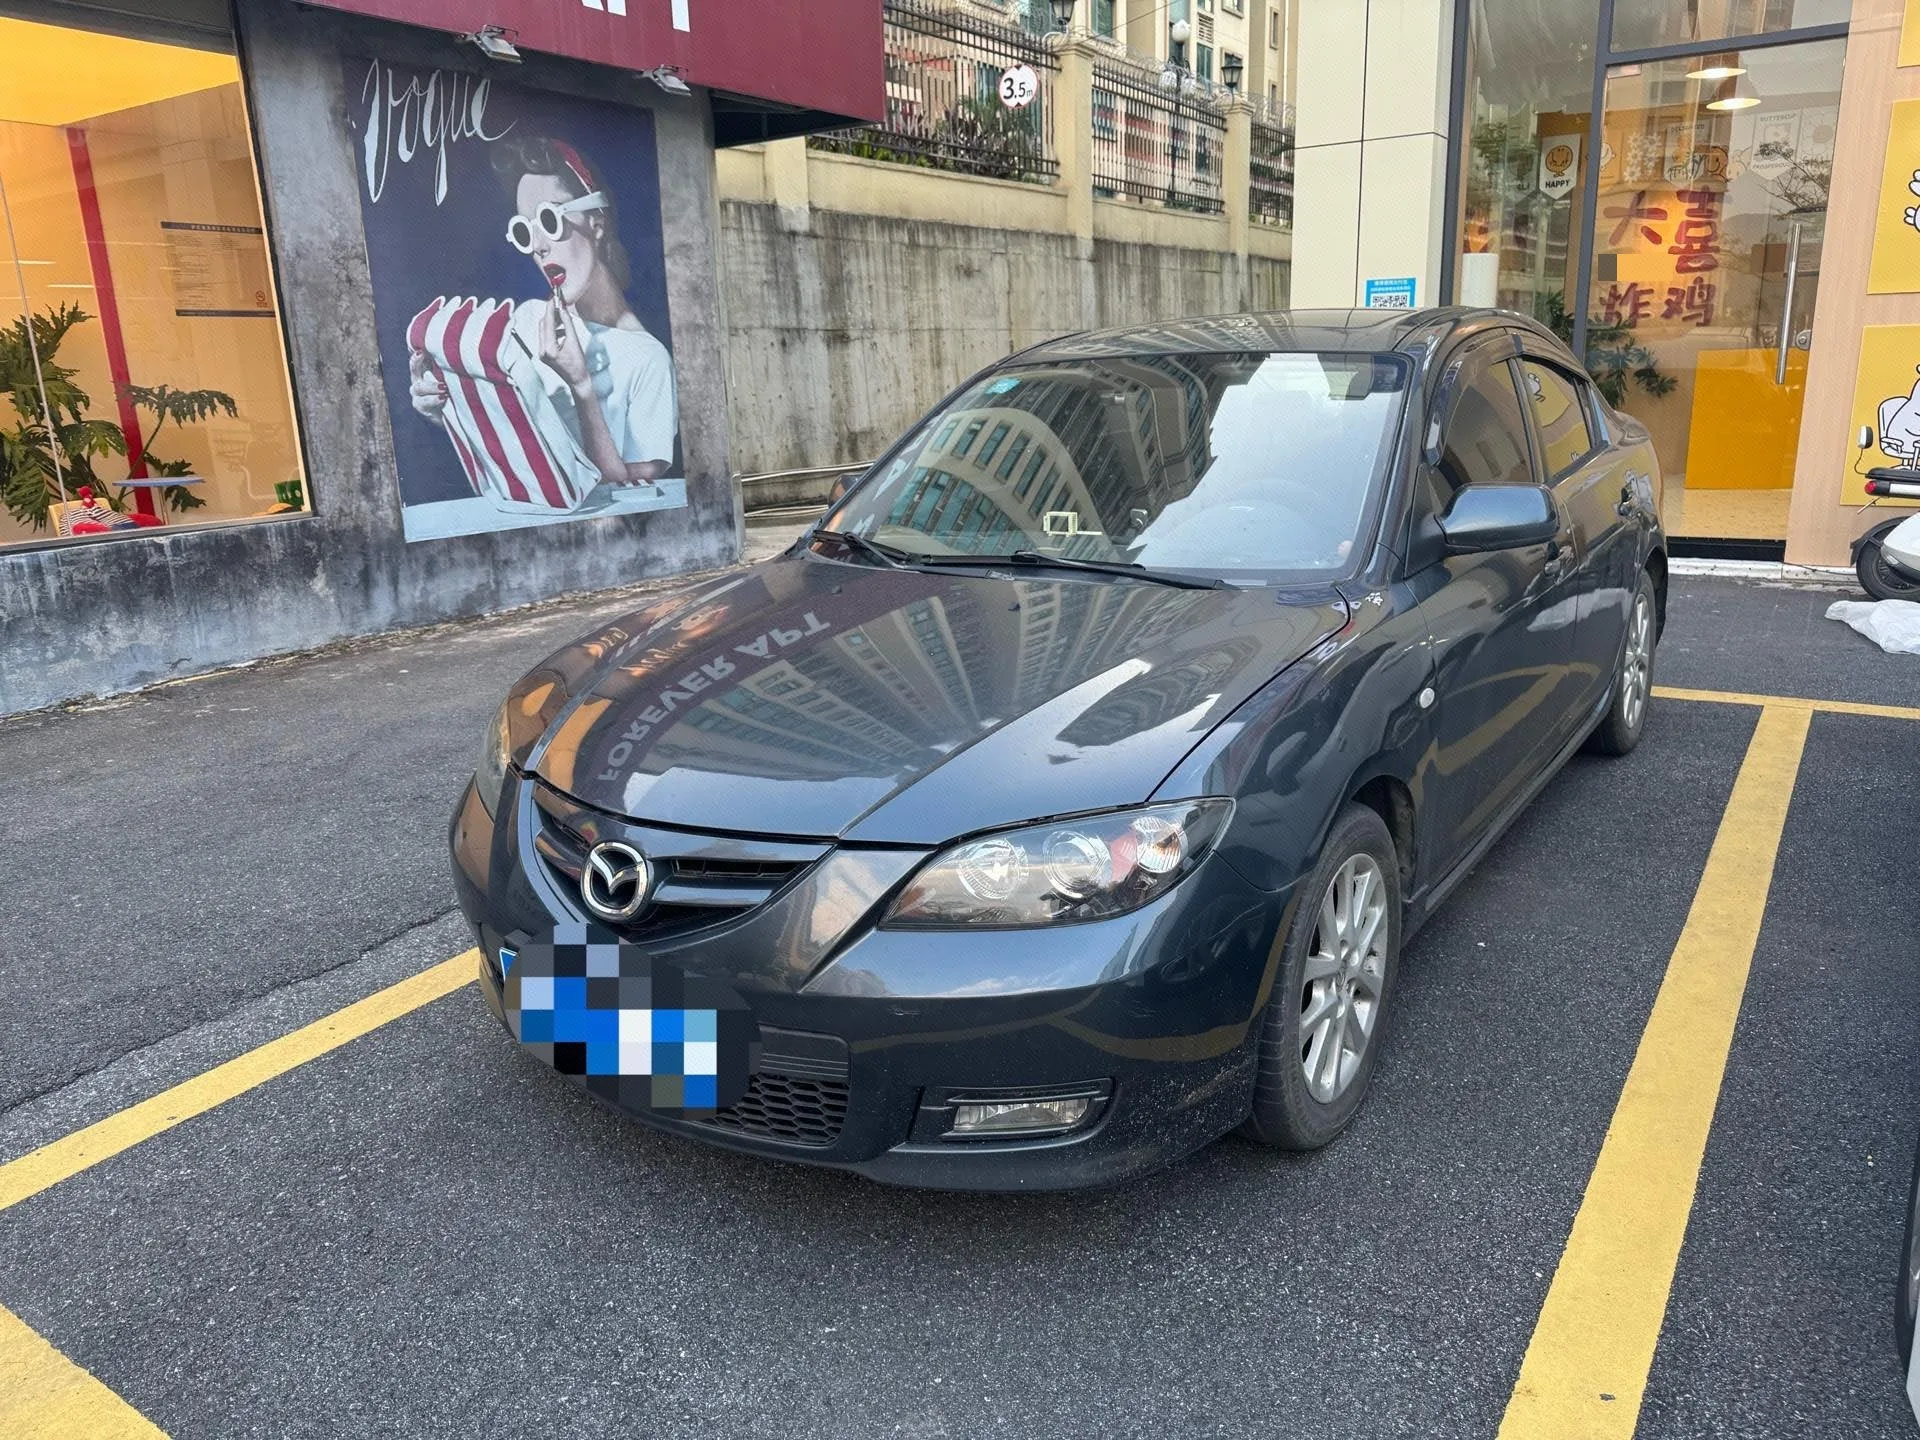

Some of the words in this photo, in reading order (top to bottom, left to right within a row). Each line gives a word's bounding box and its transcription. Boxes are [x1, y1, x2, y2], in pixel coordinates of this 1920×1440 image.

[362, 58, 518, 207] Vogue
[1545, 179, 1571, 189] HAPPY
[1603, 185, 1720, 274] 大喜
[1600, 276, 1717, 328] 炸鸡
